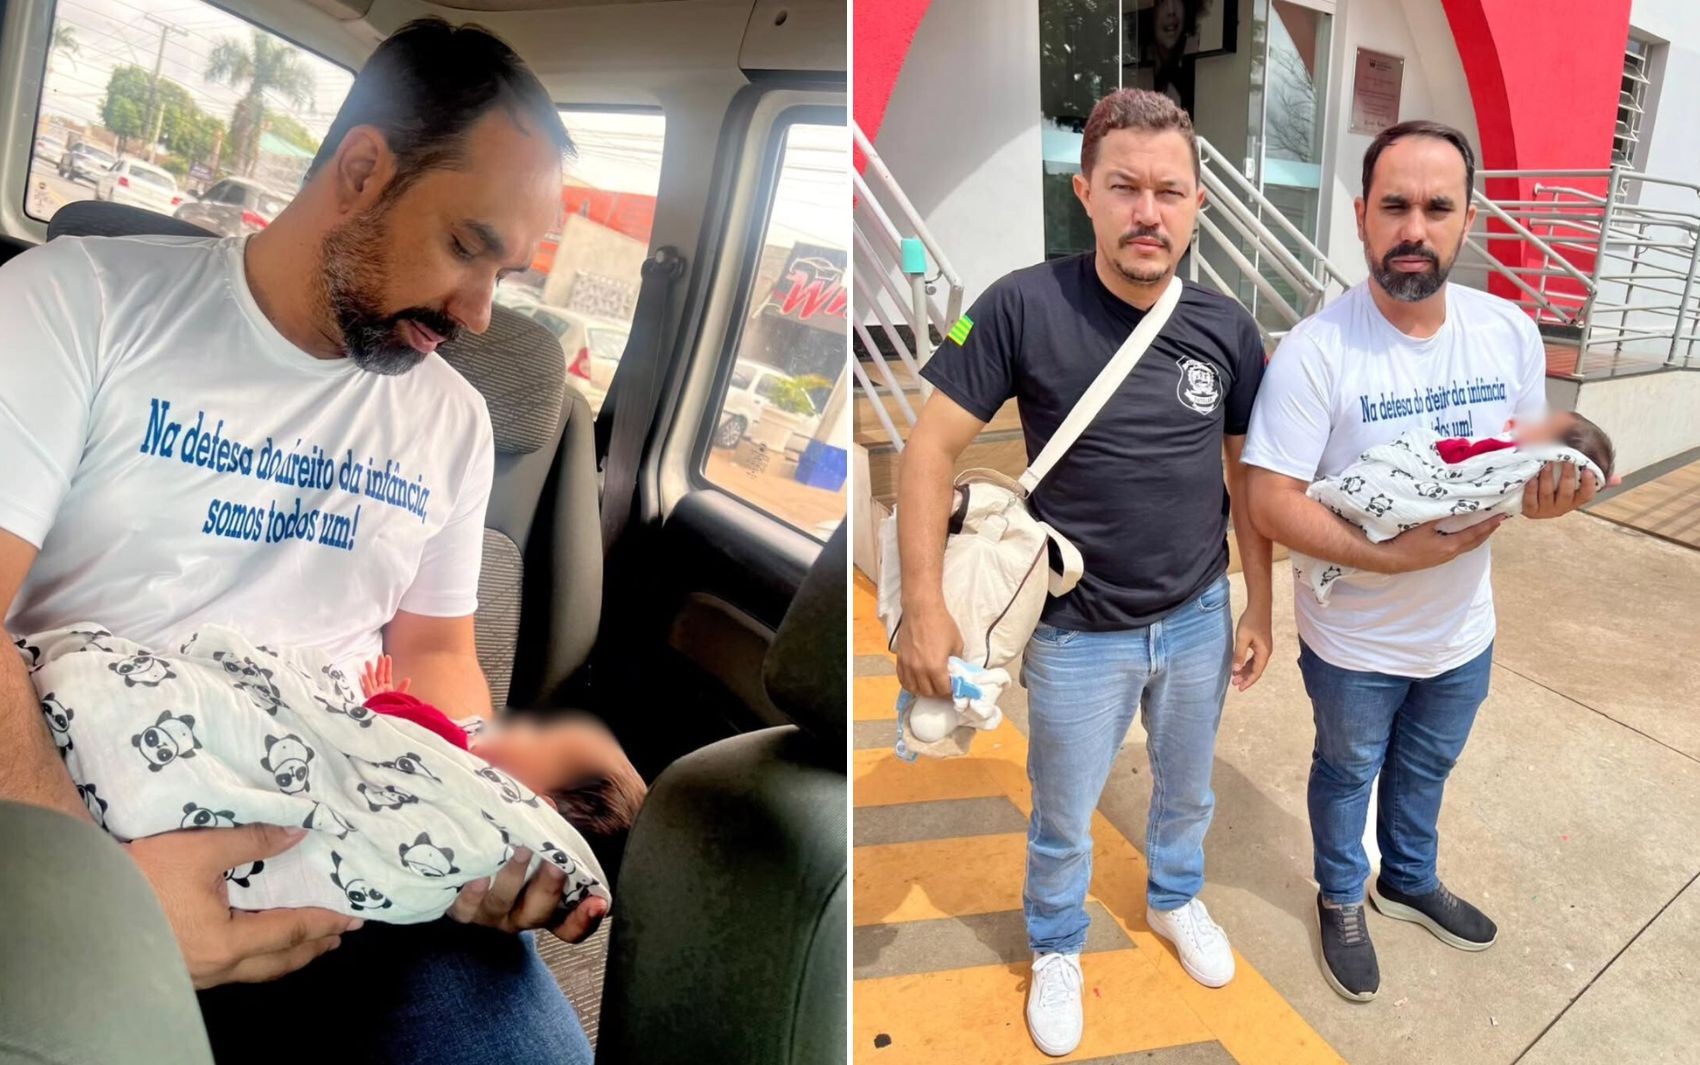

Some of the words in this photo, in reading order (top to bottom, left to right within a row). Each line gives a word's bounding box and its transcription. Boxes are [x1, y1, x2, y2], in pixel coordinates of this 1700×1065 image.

[1360, 395, 1378, 423] Na
[1379, 392, 1413, 420] defesa
[1451, 380, 1467, 406] da
[1431, 416, 1450, 437] dos
[1451, 409, 1473, 438] um!
[140, 398, 182, 458] Na
[181, 411, 254, 476] defesa
[339, 449, 363, 494] da
[365, 457, 430, 524] infância,
[202, 499, 264, 542] somos
[266, 498, 320, 543] todos
[319, 505, 360, 551] um!
